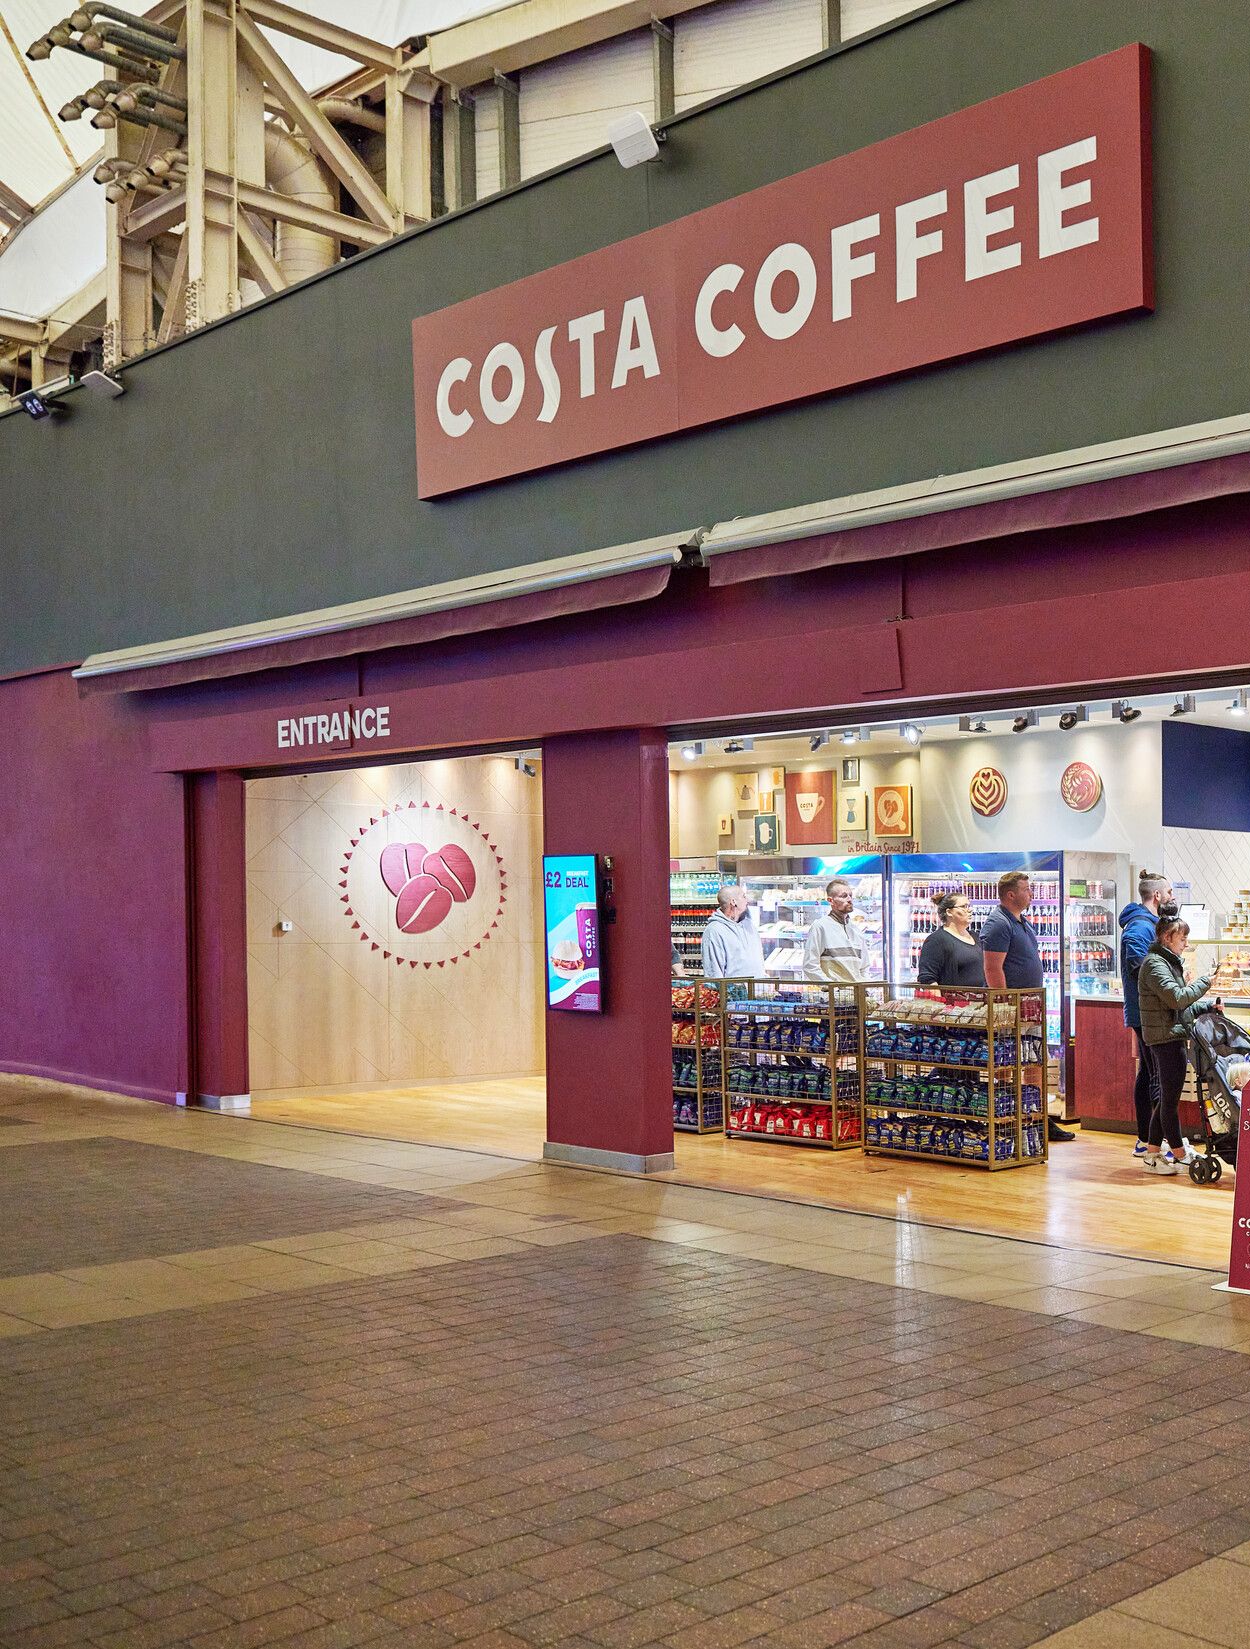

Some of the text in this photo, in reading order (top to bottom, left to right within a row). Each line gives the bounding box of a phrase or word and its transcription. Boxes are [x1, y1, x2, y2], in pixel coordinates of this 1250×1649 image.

[436, 135, 1099, 438] COSTA COFFEE
[278, 706, 391, 748] ENTRANCE
[855, 841, 882, 853] Britain
[901, 841, 920, 853] 1971
[545, 871, 562, 888] £2
[566, 877, 589, 888] DEAL
[584, 918, 592, 958] COSTA
